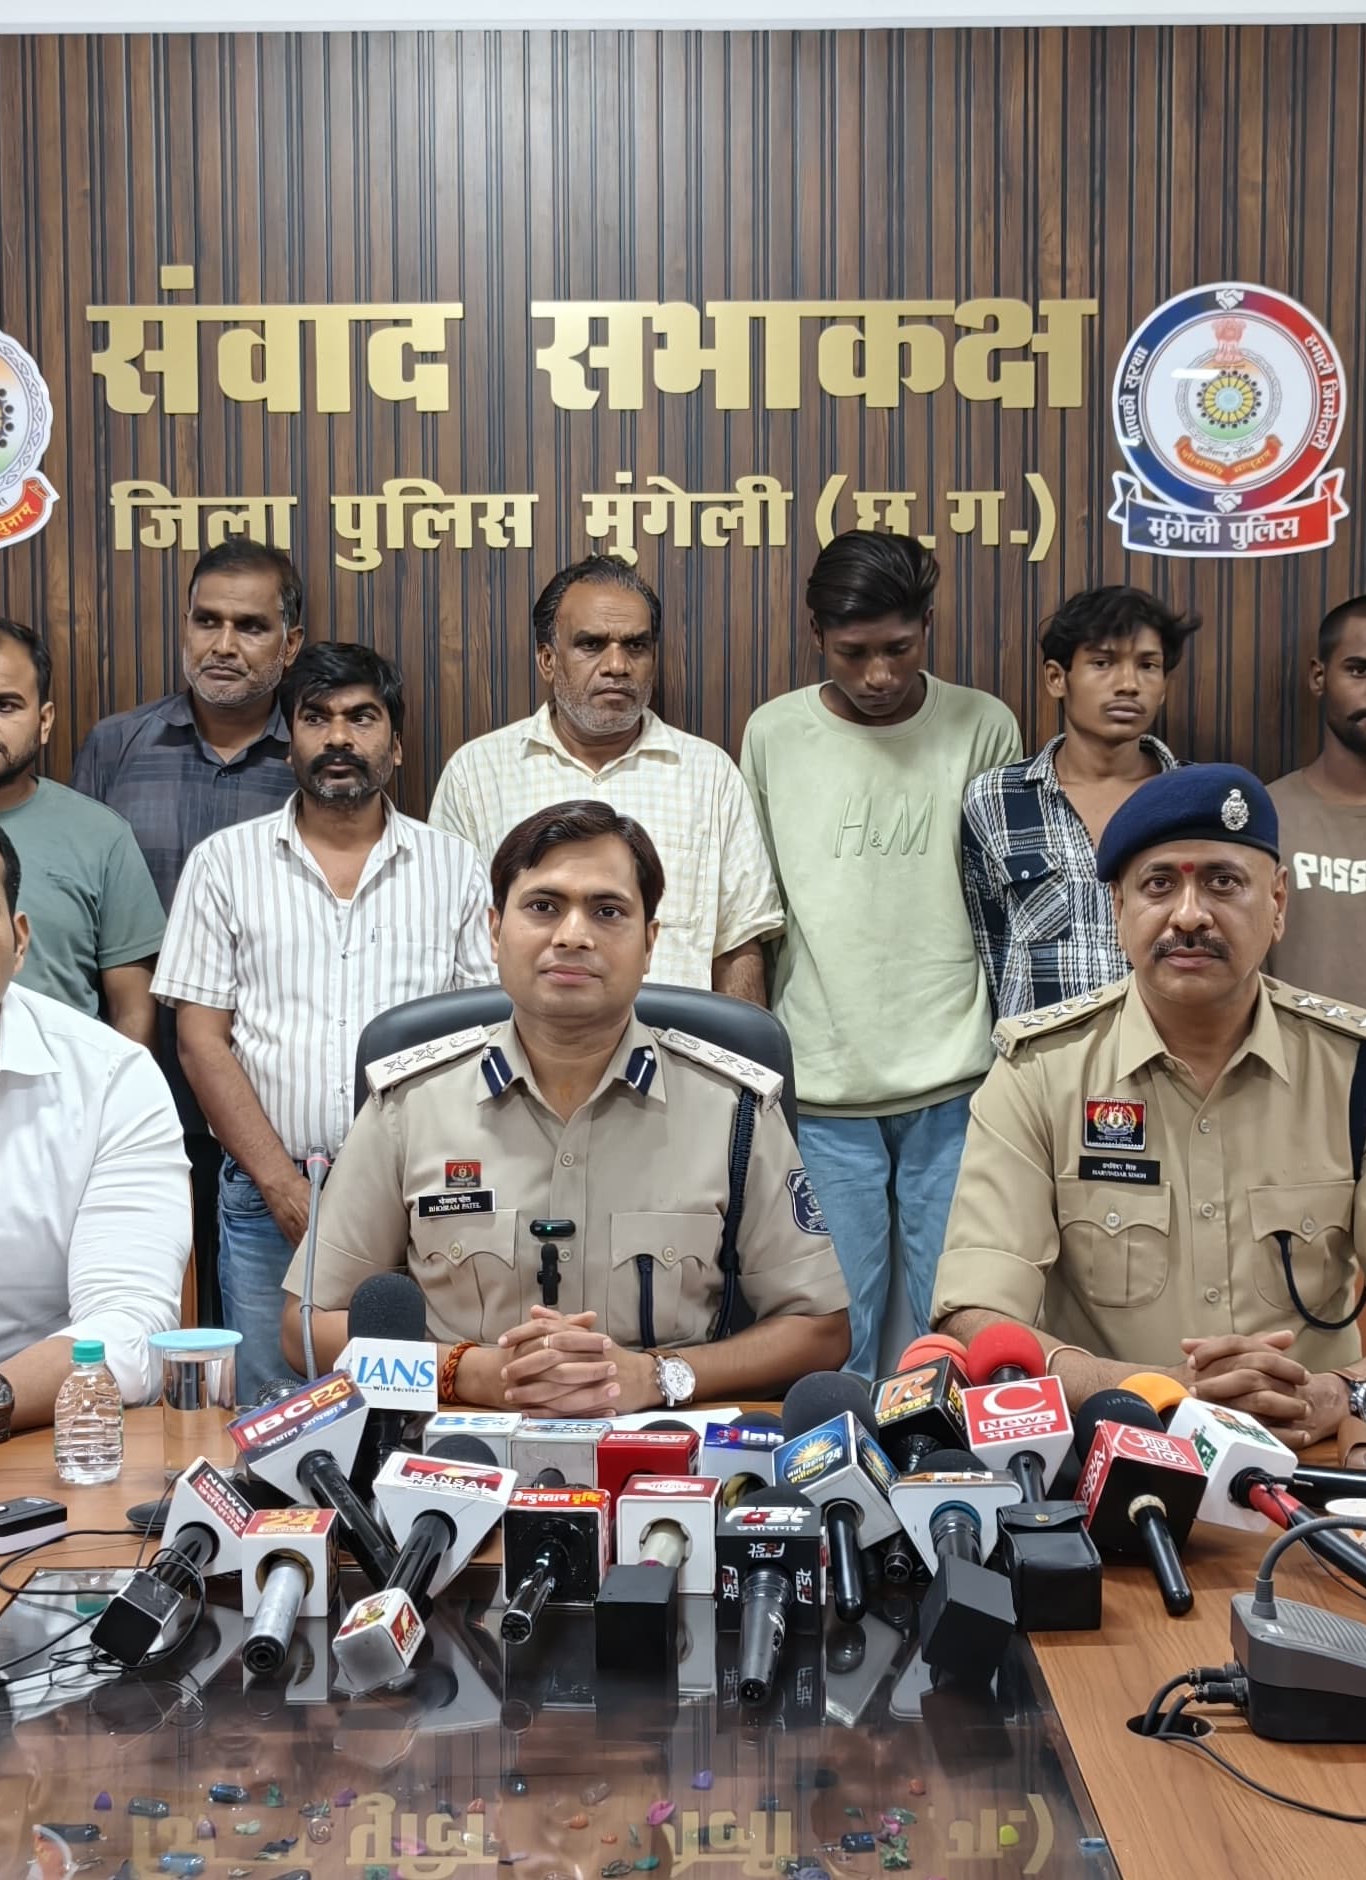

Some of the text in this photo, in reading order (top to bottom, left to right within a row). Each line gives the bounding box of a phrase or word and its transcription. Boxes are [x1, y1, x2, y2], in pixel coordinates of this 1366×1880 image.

[86, 265, 1098, 413] संवाद सभाकक्ष
[110, 480, 298, 551] जिला
[331, 478, 539, 571] पुलिस
[582, 471, 793, 565] मुंगेली
[1147, 513, 1299, 549] मुंगेली पुलिस
[834, 791, 936, 859] H&M
[461, 1202, 481, 1210] PATEL
[356, 1356, 436, 1388] IANS
[242, 1379, 349, 1441] IBC 24
[983, 1381, 1047, 1416] C
[983, 1412, 1052, 1430] News
[983, 1422, 1055, 1439] भारत
[1123, 1427, 1173, 1452] आज
[825, 1446, 844, 1465] 24
[1146, 1447, 1187, 1465] तक
[409, 1471, 490, 1490] BANSAL
[206, 1472, 248, 1519] NEWS
[262, 1513, 322, 1528] 24
